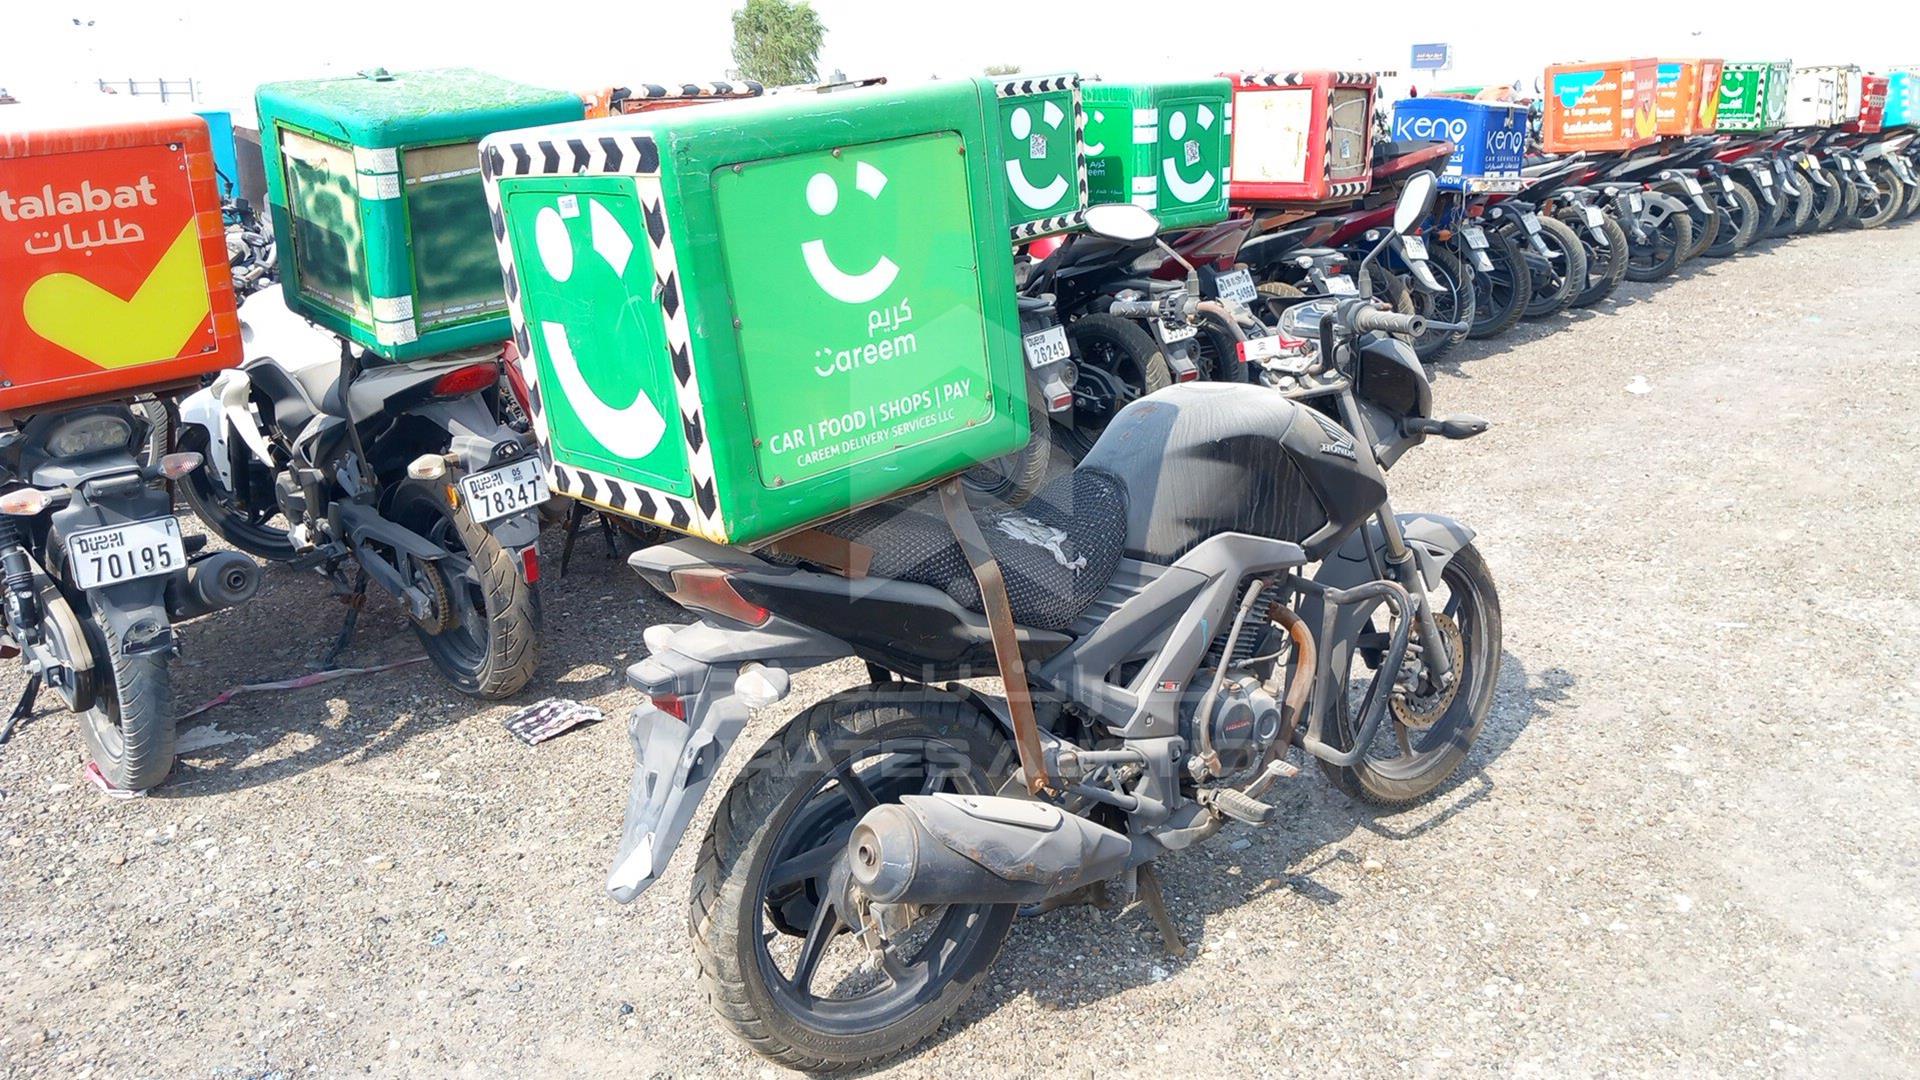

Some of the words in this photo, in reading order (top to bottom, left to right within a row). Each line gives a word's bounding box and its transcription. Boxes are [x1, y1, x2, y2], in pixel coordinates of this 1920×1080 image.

[0, 176, 157, 221] talabat
[25, 218, 145, 257] طلبات
[867, 297, 912, 338] كريم
[769, 428, 805, 455] CAR
[818, 410, 866, 440] FOOD
[879, 390, 932, 422] SHOPS
[943, 378, 971, 401] PAY
[797, 445, 840, 467] CAREEM
[841, 430, 889, 454] DELIVERY
[891, 415, 937, 438] SERVICES
[937, 408, 955, 422] LLC
[1320, 442, 1357, 461] HONDA
[480, 479, 537, 517] 78347
[90, 543, 171, 583] 70195
